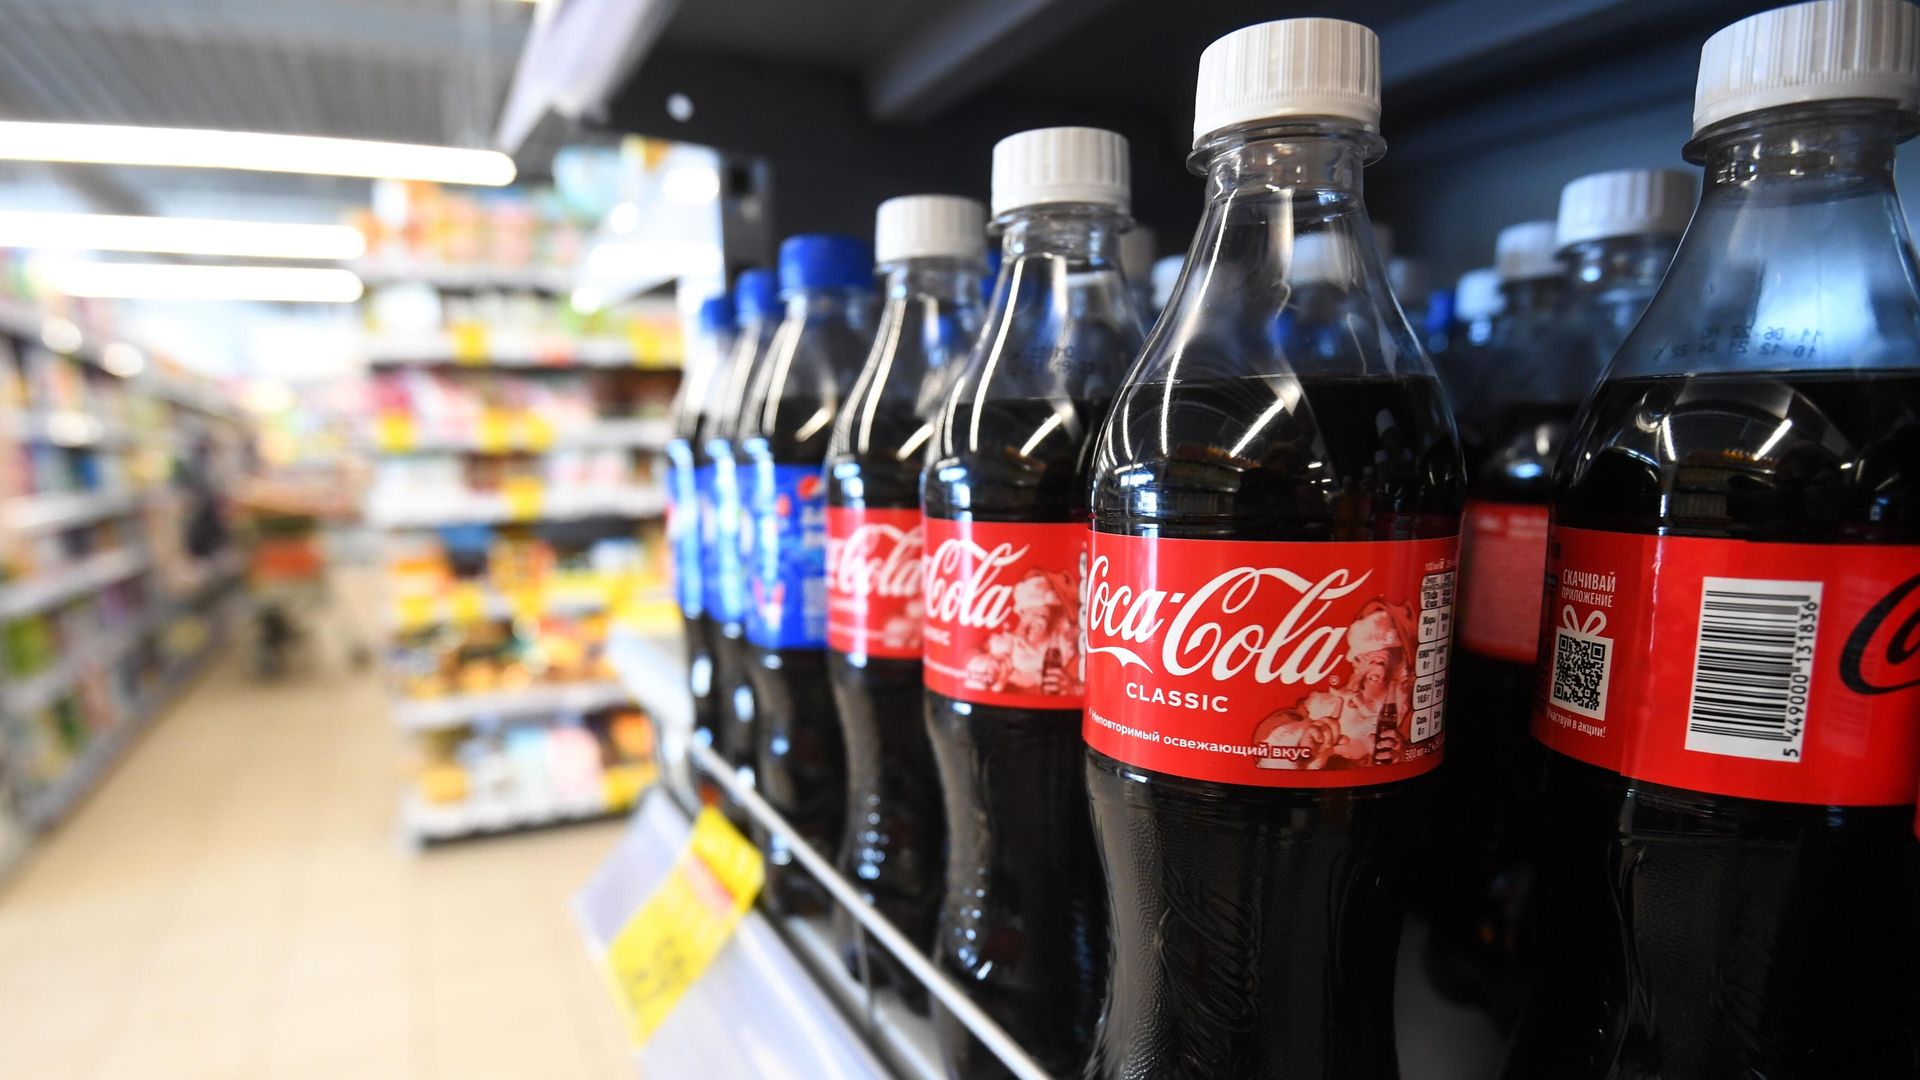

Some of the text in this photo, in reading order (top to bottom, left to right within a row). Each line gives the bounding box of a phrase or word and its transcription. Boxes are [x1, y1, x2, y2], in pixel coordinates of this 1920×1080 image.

[1562, 568, 1617, 593] СКАЧИВАЙ
[1560, 586, 1614, 608] ПРИЛОЖЕНИЕ
[1085, 555, 1374, 685] Coca-Cola
[1783, 601, 1818, 758] 5 449000 131836
[1125, 682, 1229, 713] CLASSIC
[1091, 711, 1311, 762] Неповторимый освежающий вкус
[1572, 719, 1577, 729] в
[1577, 721, 1607, 738] акции!
